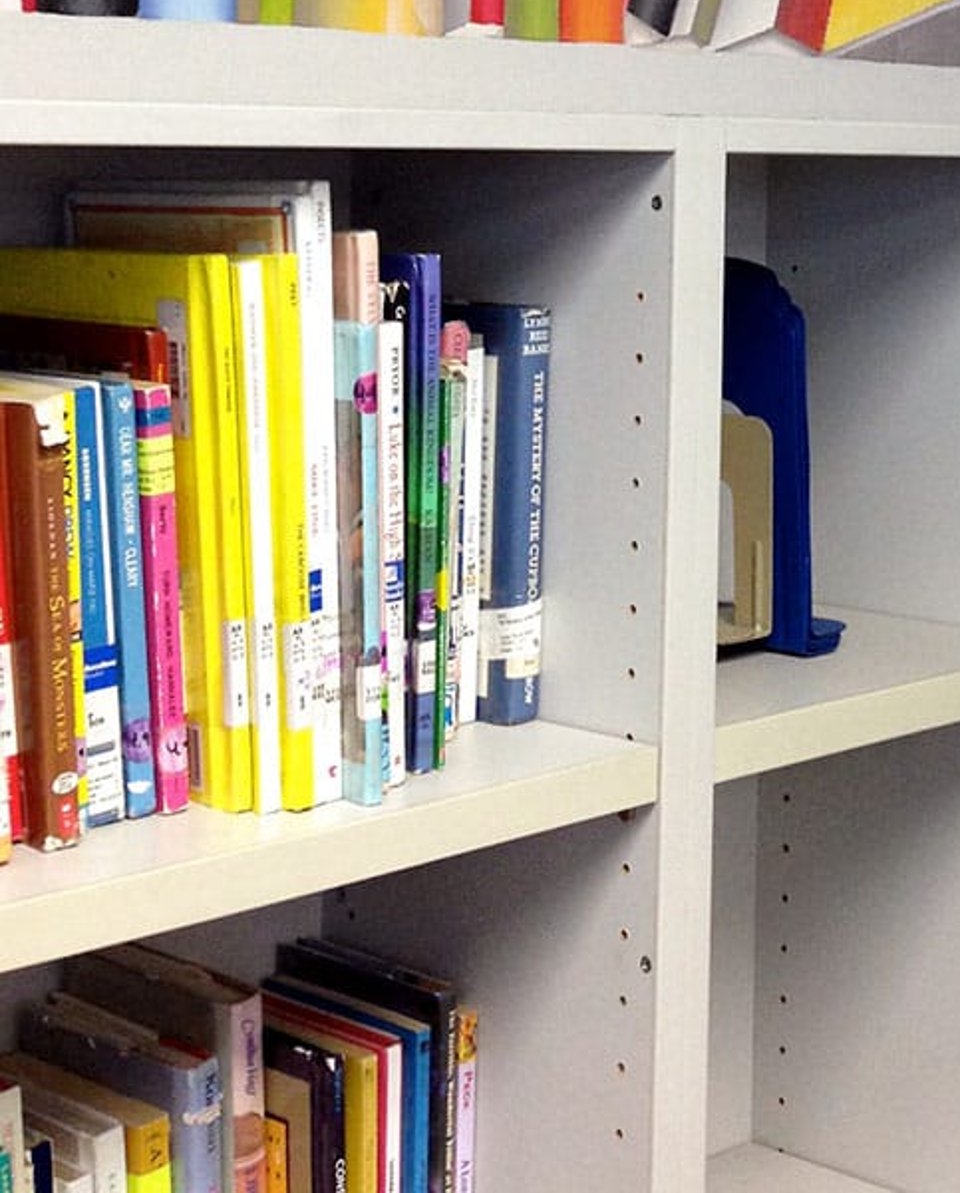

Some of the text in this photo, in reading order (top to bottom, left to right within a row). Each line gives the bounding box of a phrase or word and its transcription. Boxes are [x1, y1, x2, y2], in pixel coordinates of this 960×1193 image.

[426, 378, 435, 424] ANIMAL
[532, 371, 543, 402] THE
[529, 406, 543, 480] MYSTERY
[529, 485, 541, 504] OF
[528, 509, 540, 540] THE
